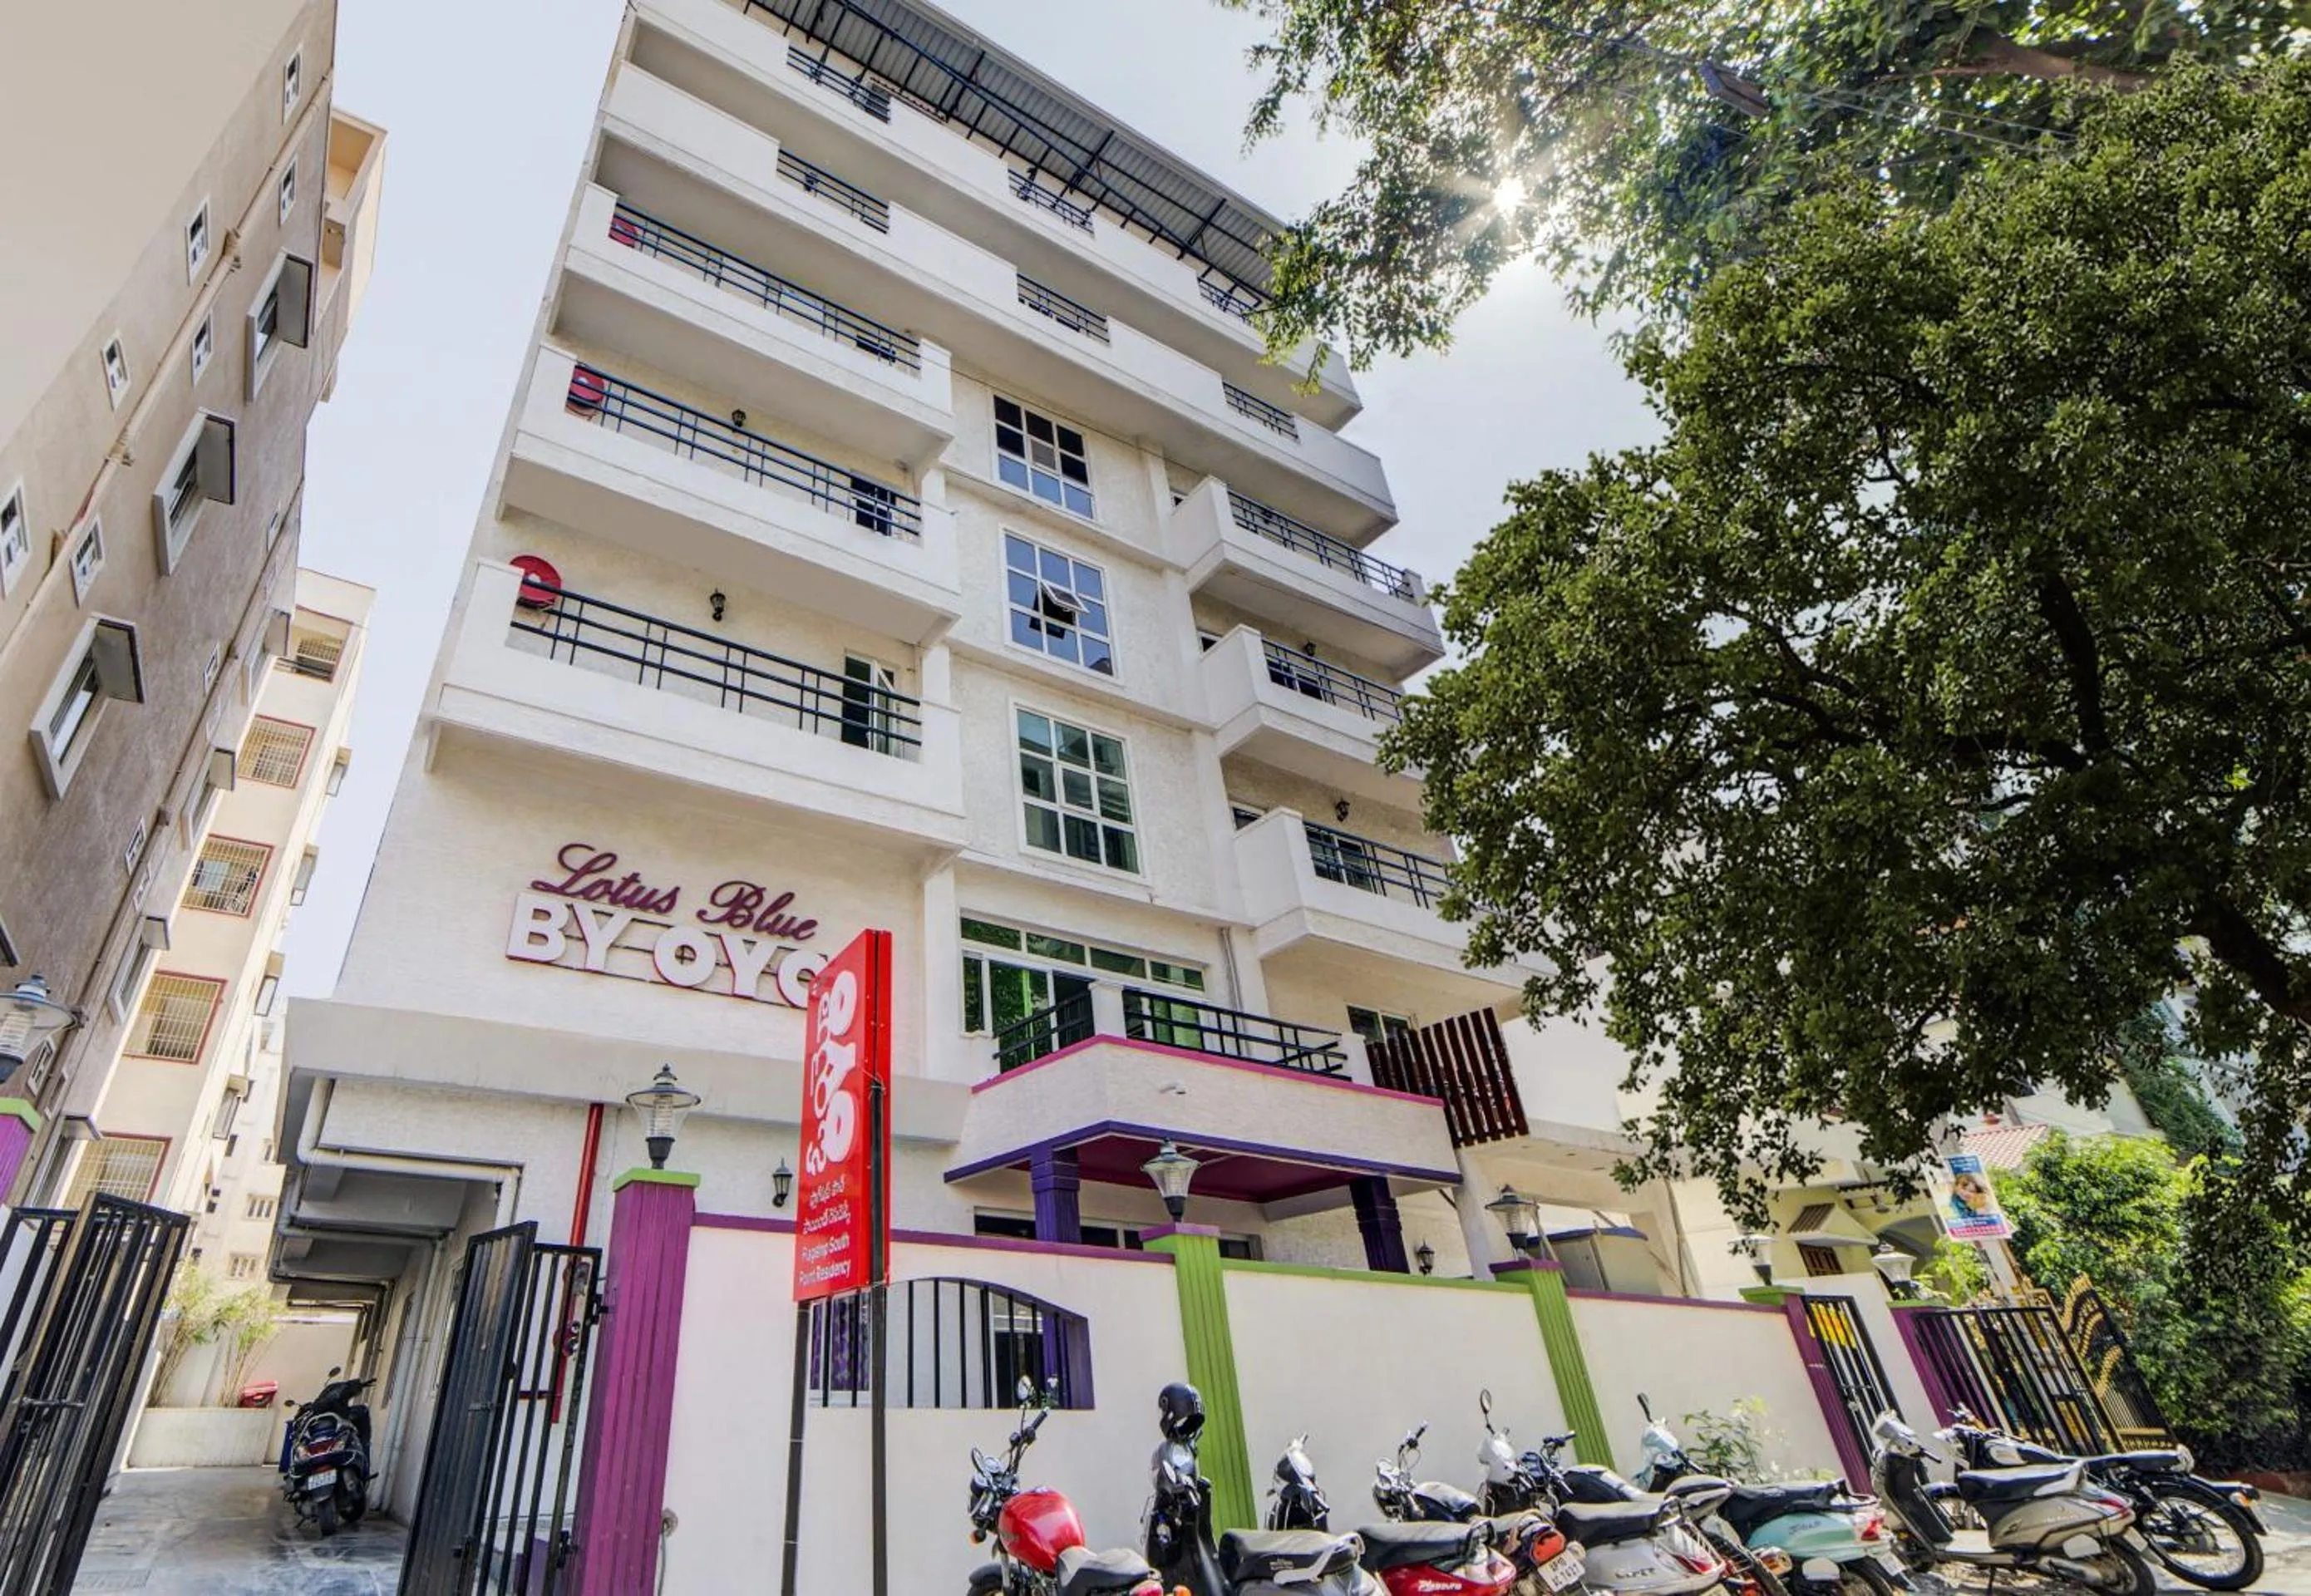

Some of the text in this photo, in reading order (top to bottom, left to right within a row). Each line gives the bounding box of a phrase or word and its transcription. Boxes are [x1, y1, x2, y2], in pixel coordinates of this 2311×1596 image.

[505, 891, 633, 973] BY
[531, 843, 820, 941] Lotus Blue
